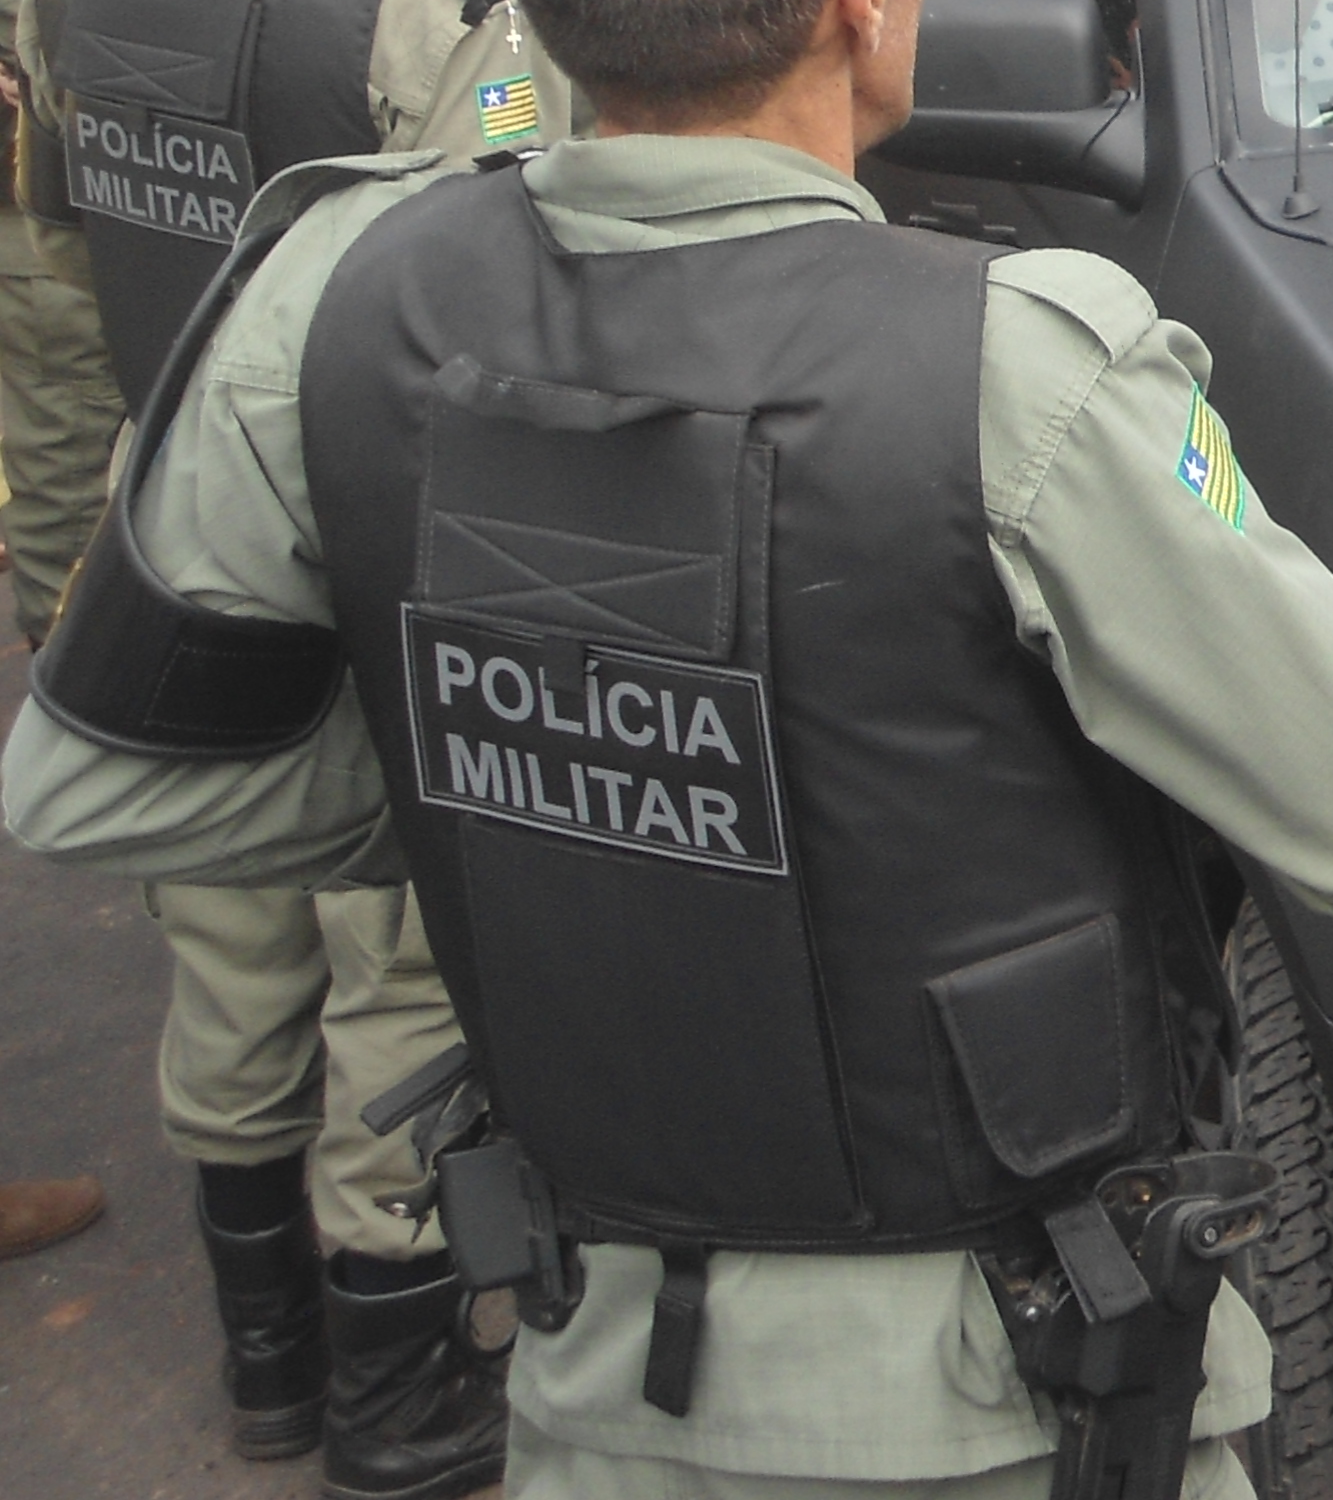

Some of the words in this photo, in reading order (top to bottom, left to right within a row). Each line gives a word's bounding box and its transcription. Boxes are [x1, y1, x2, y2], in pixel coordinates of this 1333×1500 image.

[76, 111, 239, 185] POLÍCIA
[82, 165, 239, 236] MILITAR
[434, 640, 742, 766] POLÍCIA
[445, 731, 748, 857] MILITAR
